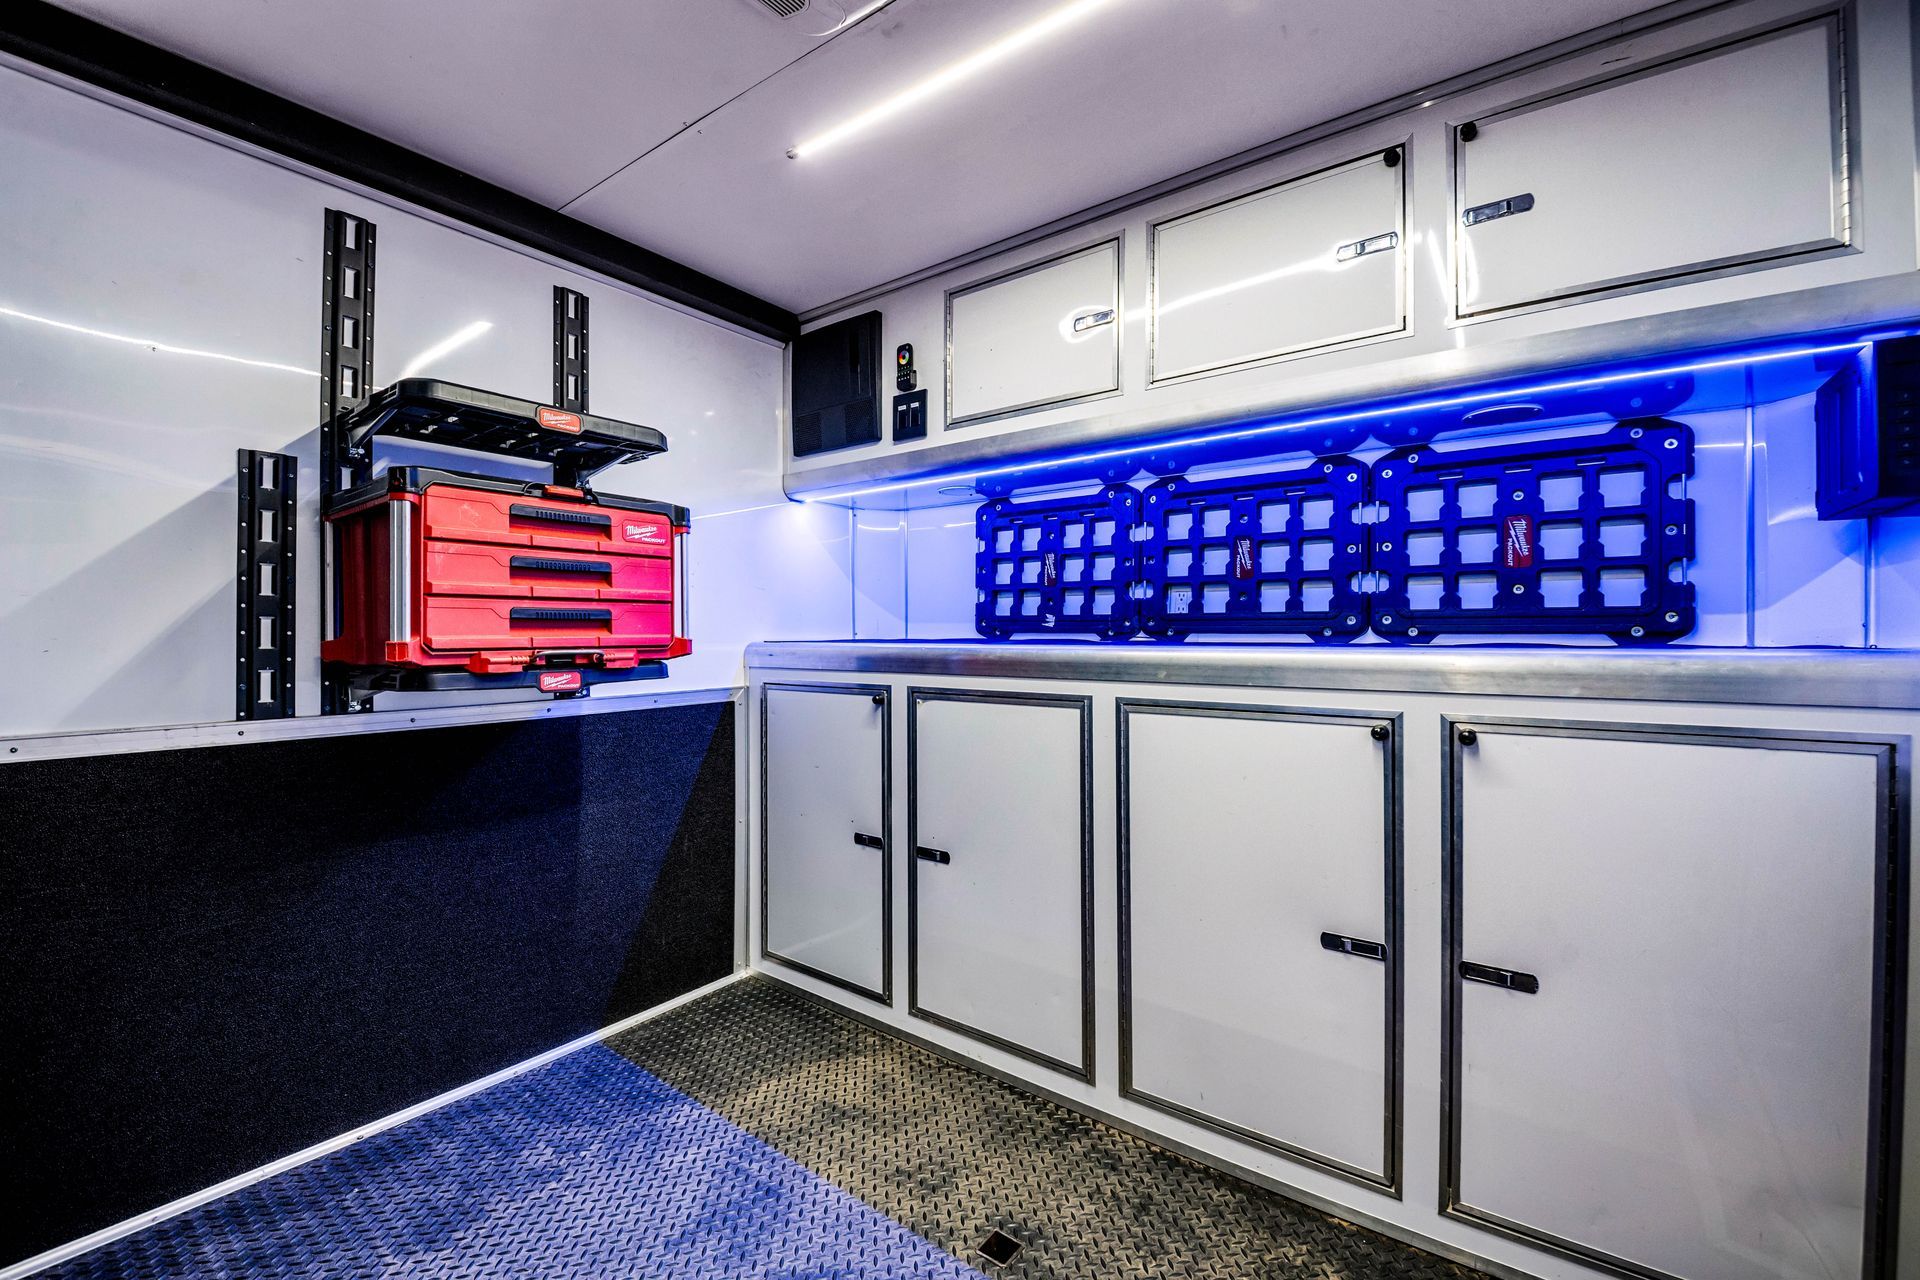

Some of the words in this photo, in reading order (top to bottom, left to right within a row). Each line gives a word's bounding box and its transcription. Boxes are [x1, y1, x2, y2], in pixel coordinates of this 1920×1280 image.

[625, 525, 657, 536] Milwaukee
[1512, 519, 1530, 556] Milwaukee
[543, 673, 572, 686] Milwaukee
